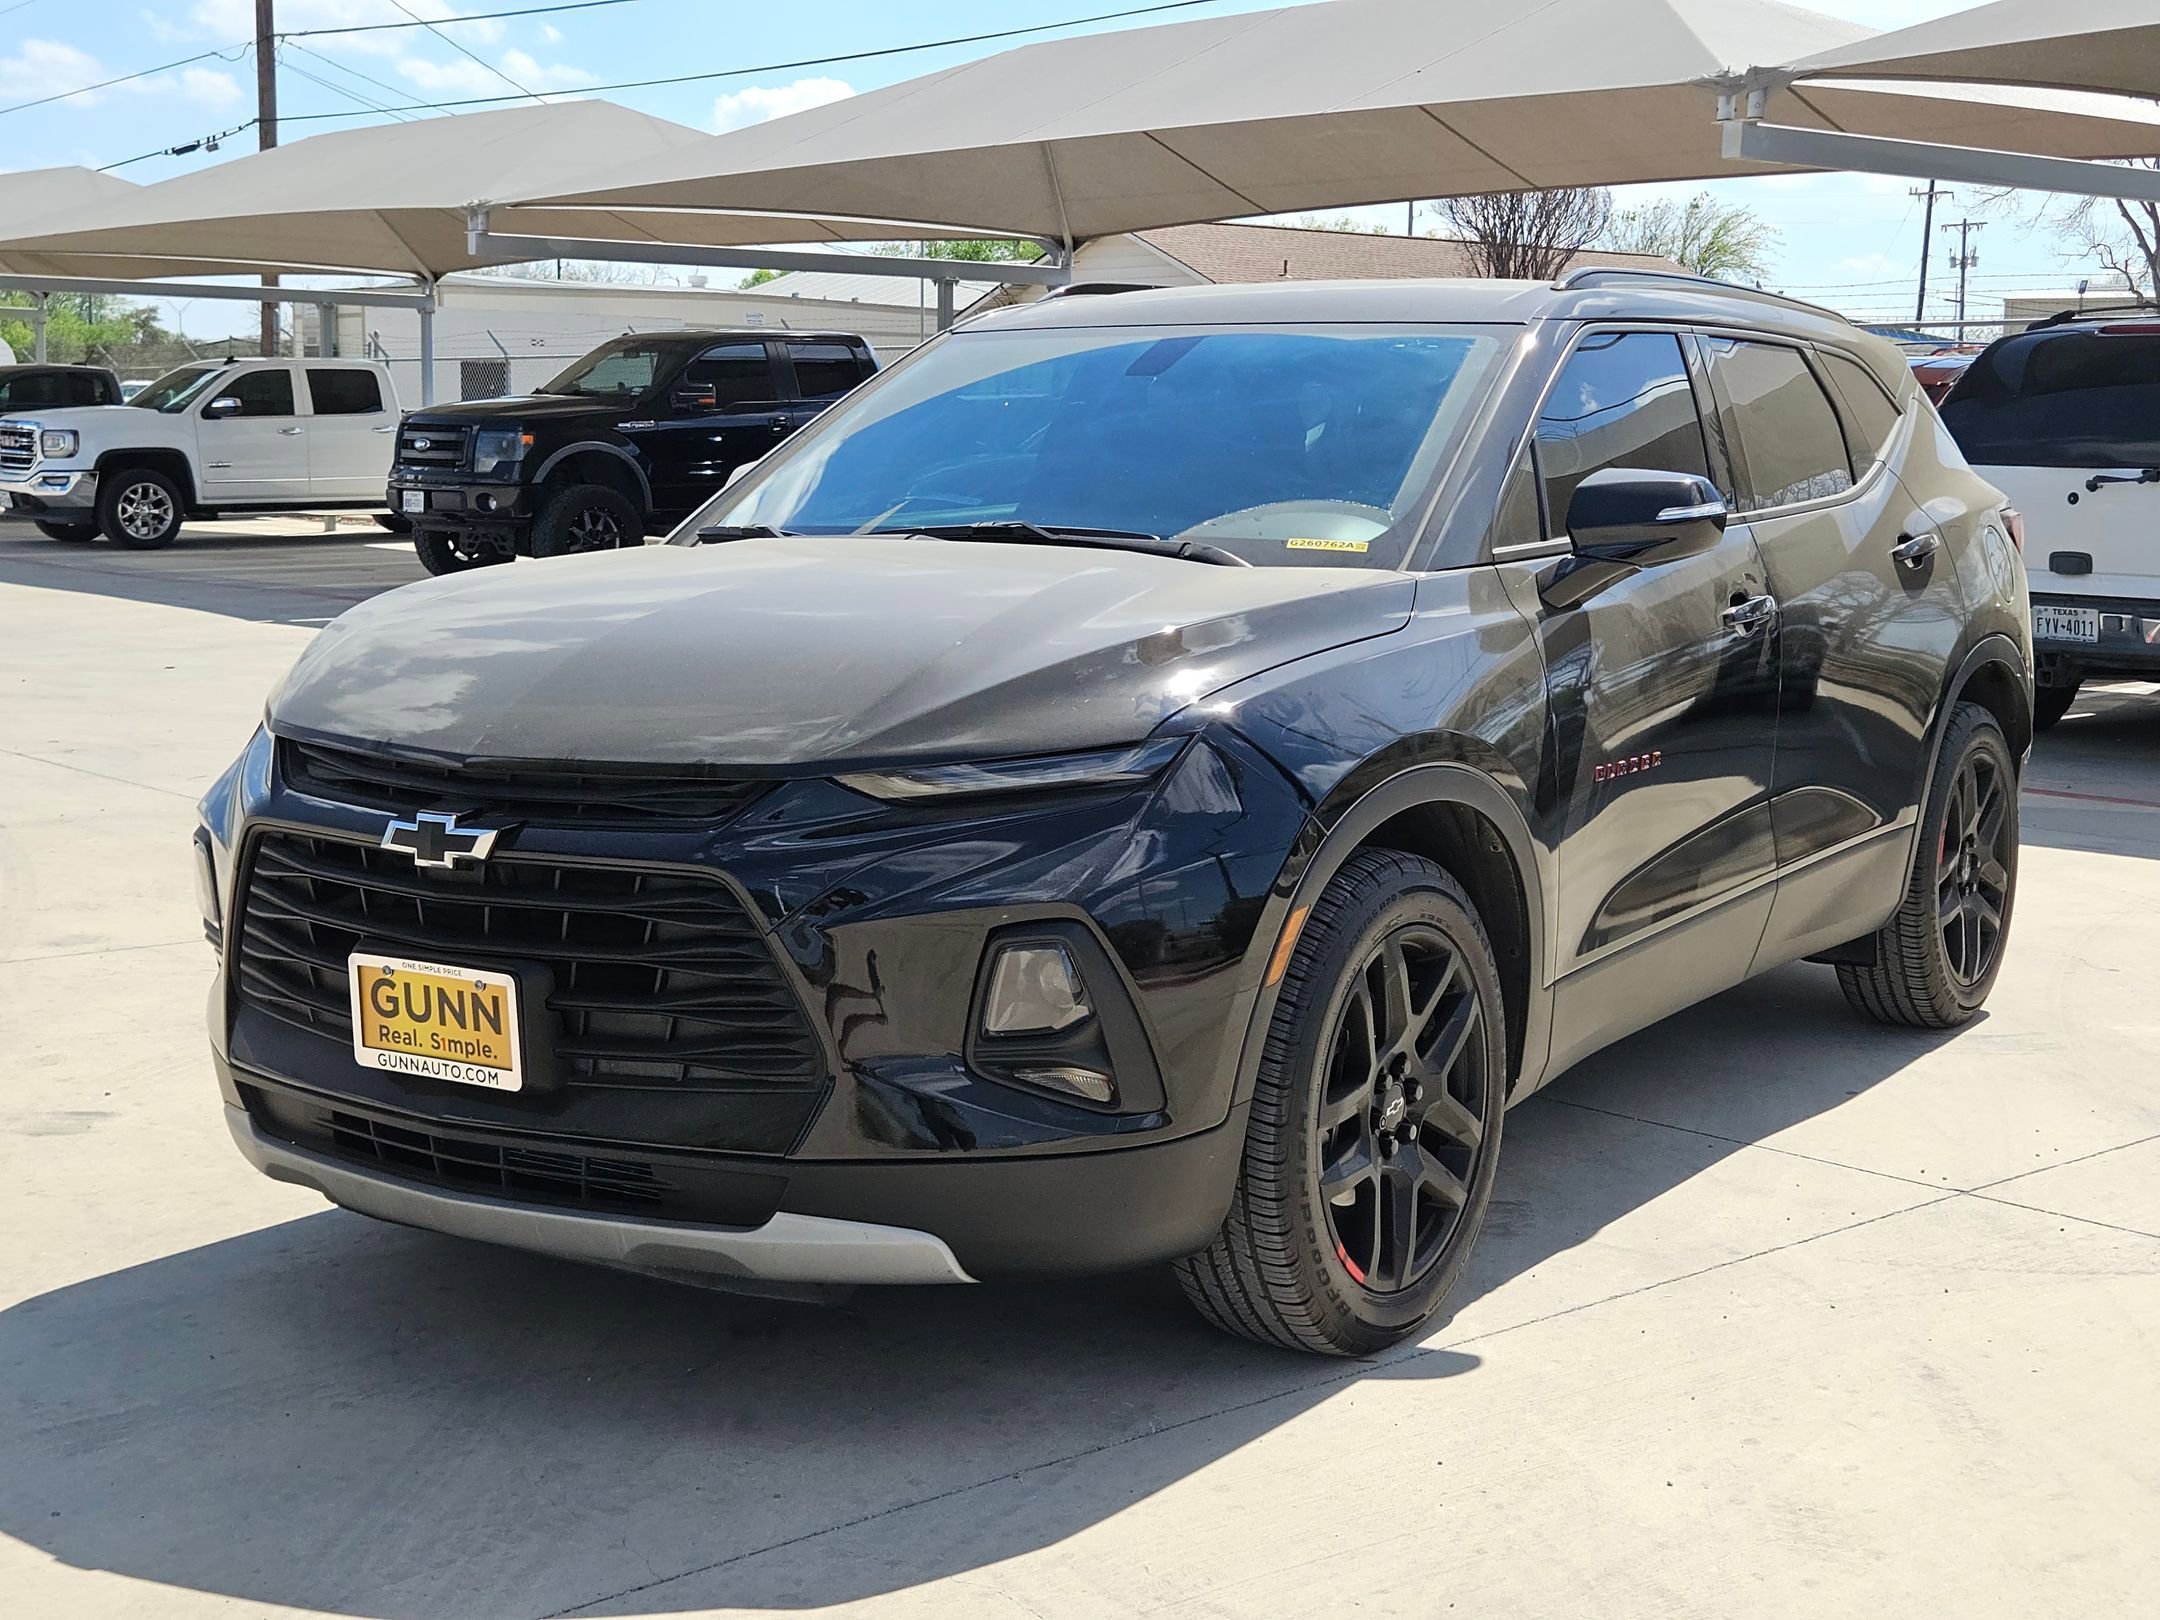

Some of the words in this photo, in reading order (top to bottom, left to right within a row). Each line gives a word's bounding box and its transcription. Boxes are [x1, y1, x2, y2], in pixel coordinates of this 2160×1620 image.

[1289, 539, 1354, 549] G260762A
[2052, 608, 2079, 616] TEXAS
[401, 961, 416, 970] ONE
[418, 964, 441, 974] SIMPLE
[442, 967, 462, 977] PRICE
[370, 977, 503, 1035] GUNN
[379, 1024, 423, 1048] Real.
[377, 1053, 499, 1086] GUNNAUTO.COM
